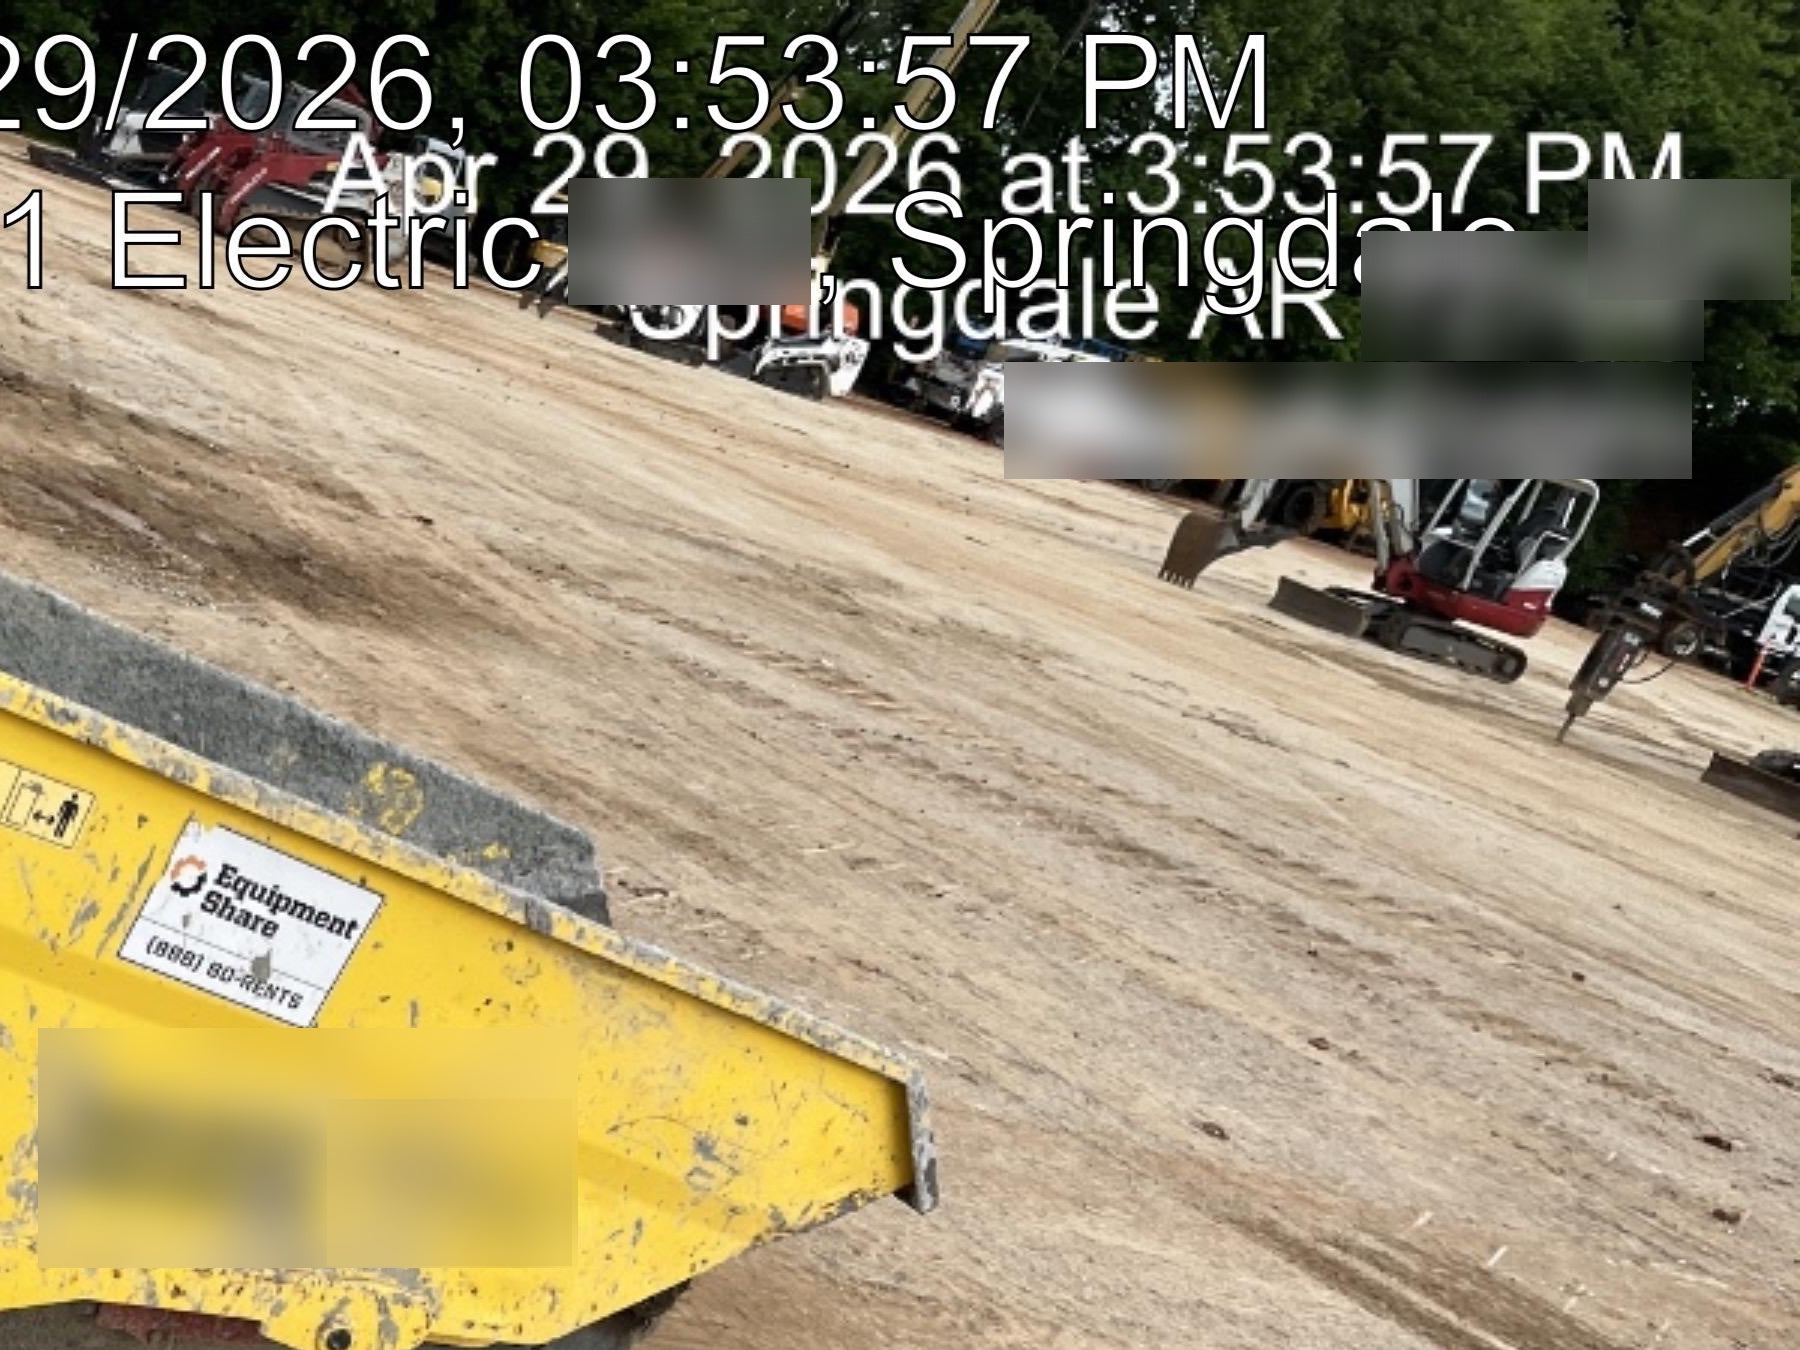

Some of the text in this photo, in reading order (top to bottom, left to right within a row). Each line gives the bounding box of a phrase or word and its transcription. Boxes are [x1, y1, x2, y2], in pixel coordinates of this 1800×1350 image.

[200, 890, 279, 938] Share
[214, 863, 359, 940] Equipment
[145, 935, 304, 1010] (888) 80-RENTS
